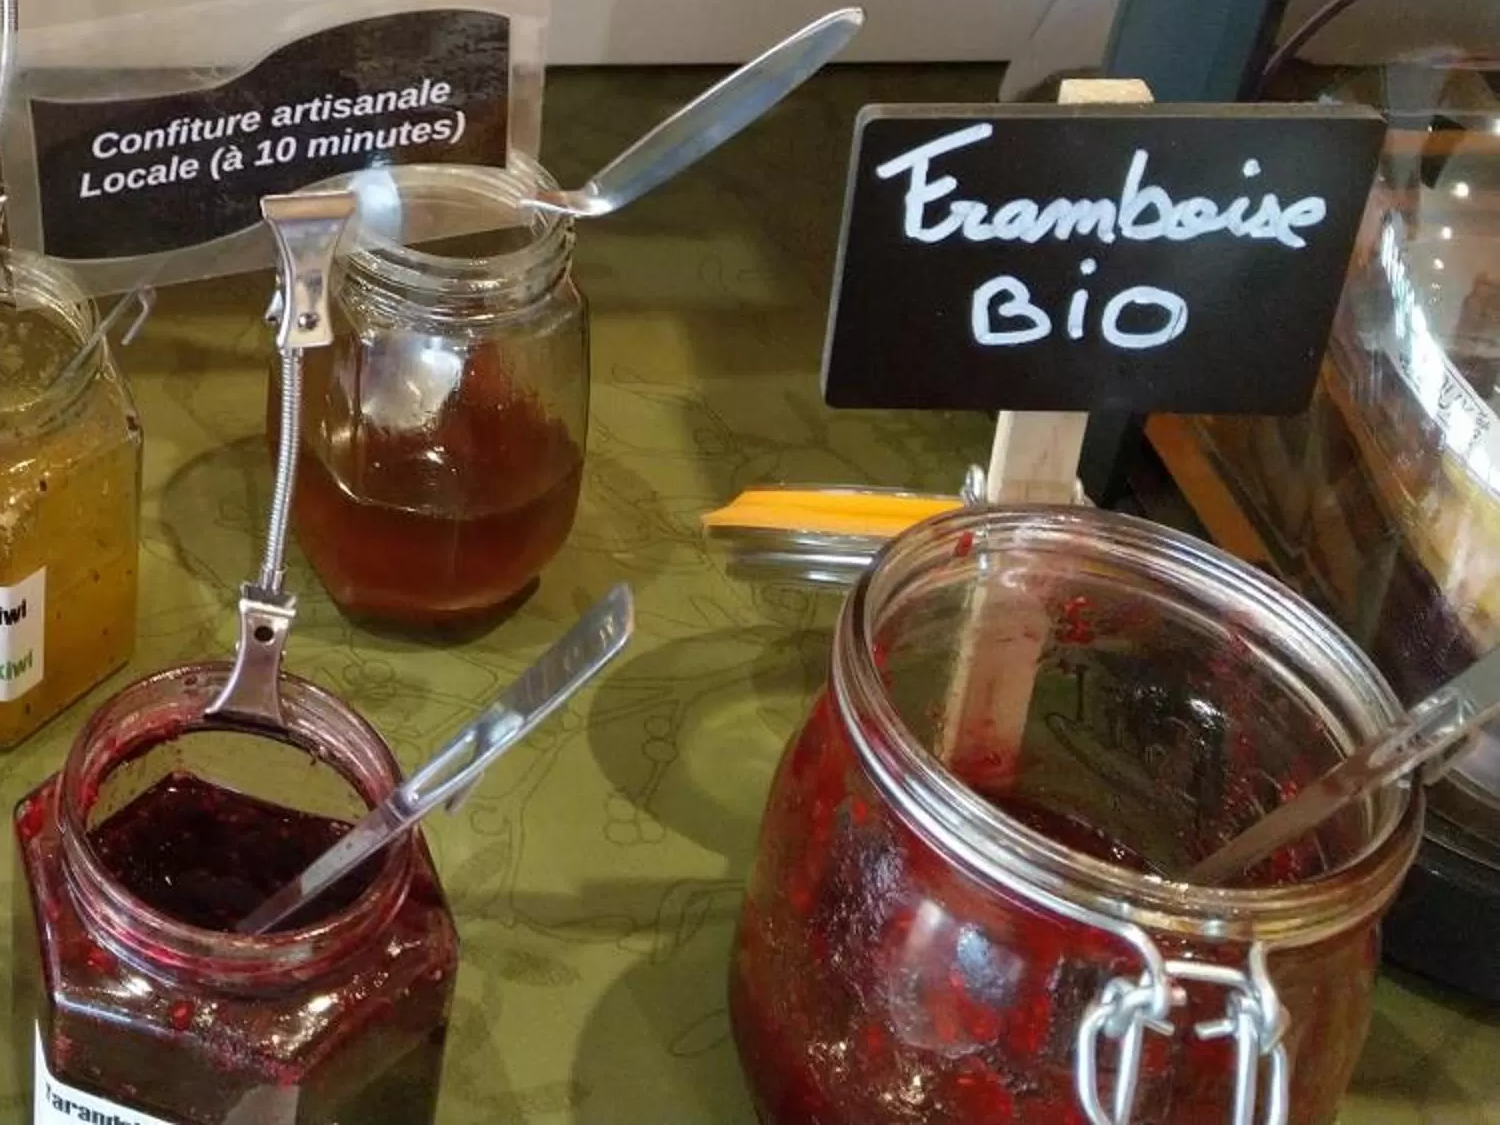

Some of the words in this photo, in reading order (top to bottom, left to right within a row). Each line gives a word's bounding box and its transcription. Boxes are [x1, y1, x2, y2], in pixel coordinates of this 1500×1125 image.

[78, 150, 200, 200] Locale
[209, 144, 244, 181] (à
[253, 134, 298, 168] 10
[306, 111, 468, 162] minutes)
[90, 105, 262, 160] Confiture
[270, 77, 452, 130] artisanale
[875, 121, 1328, 249] Framboise
